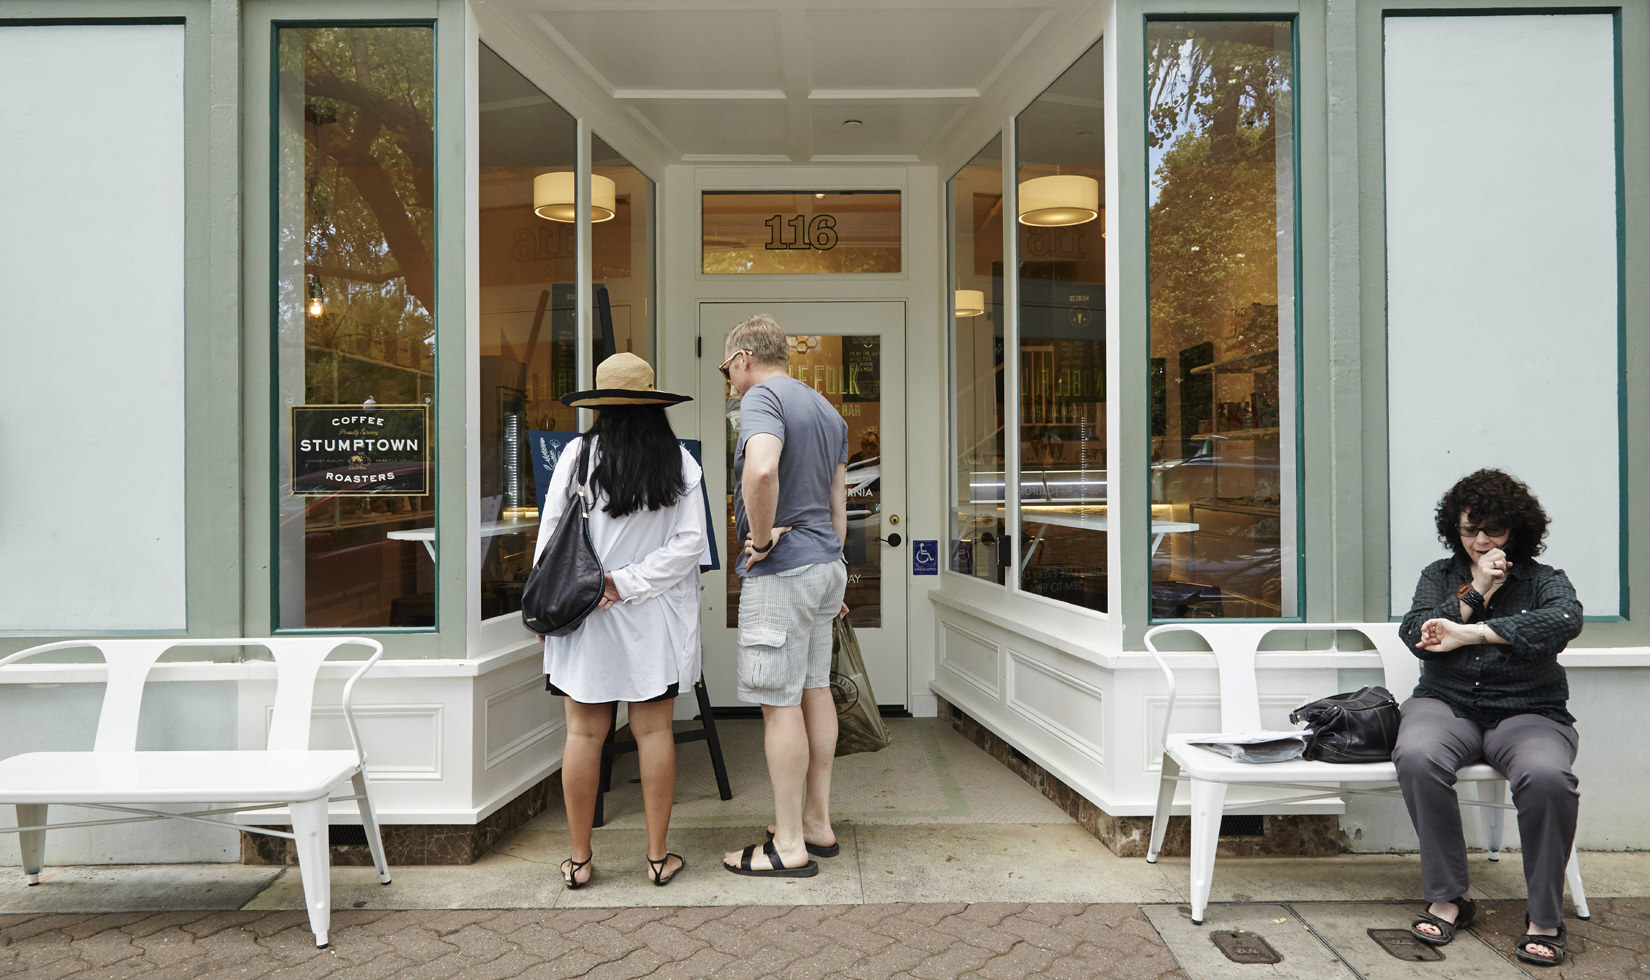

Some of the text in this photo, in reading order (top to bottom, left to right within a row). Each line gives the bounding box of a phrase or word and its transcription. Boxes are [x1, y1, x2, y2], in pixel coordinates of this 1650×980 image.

[764, 214, 838, 251] 116
[814, 365, 861, 395] FOLK
[331, 416, 385, 426] COFFEE
[300, 439, 419, 452] STUMPTOWN
[325, 472, 396, 483] ROASTERS
[847, 574, 862, 584] AY
